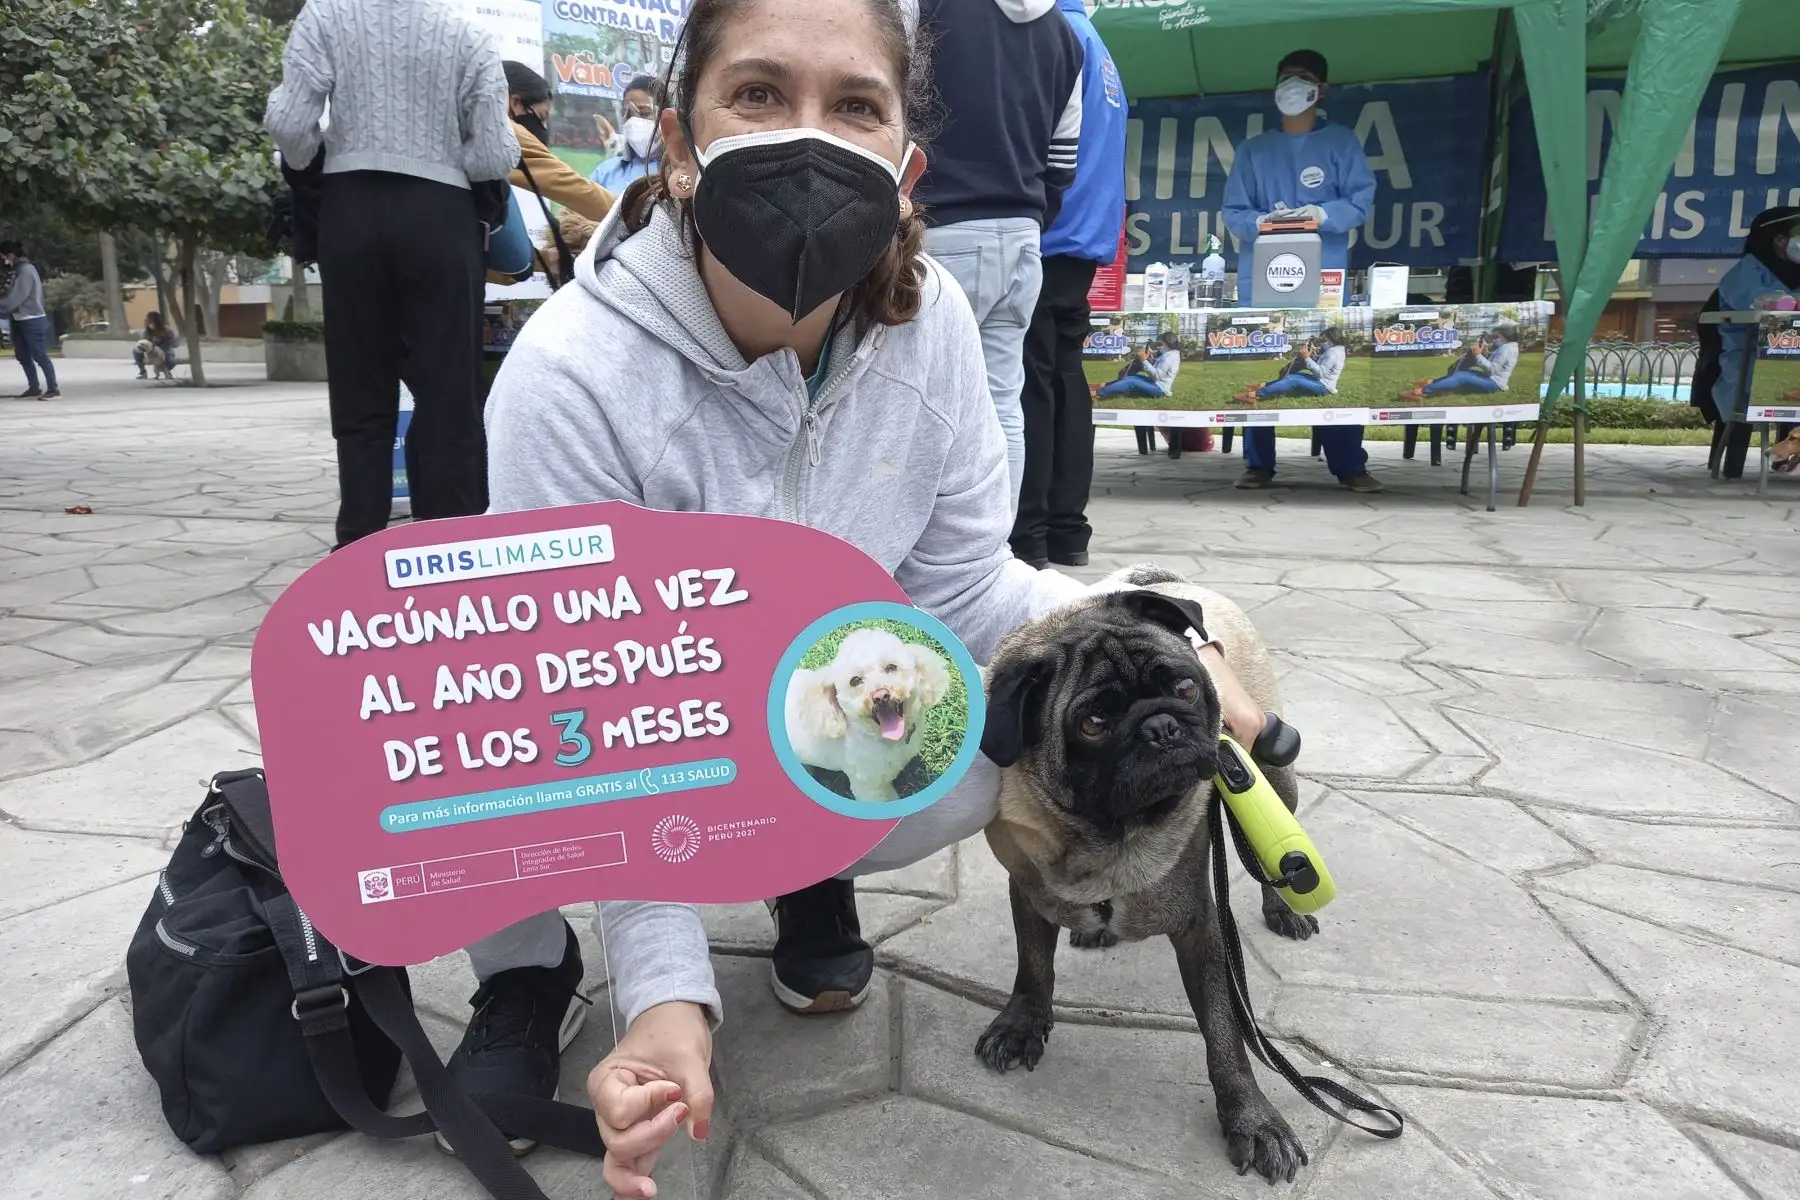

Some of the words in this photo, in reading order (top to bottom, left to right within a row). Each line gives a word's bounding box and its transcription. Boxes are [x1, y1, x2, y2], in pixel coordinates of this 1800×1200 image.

[557, 1, 632, 28] CONTRA
[635, 14, 656, 33] LA
[1268, 266, 1304, 276] MINSA
[307, 595, 537, 656] VACÚNALO
[553, 575, 642, 623] UNA
[654, 568, 748, 610] VEZ
[360, 674, 416, 720] AL
[432, 663, 522, 710] AÑO
[535, 620, 722, 693] DESPUÉS
[383, 736, 443, 781] DE
[456, 728, 538, 769] LOS
[550, 708, 592, 768] 3
[602, 699, 730, 750] MESES
[388, 813, 418, 825] Para
[422, 806, 450, 821] más
[453, 794, 533, 816] información
[536, 790, 572, 804] llama
[575, 780, 622, 796] GRATIS
[625, 778, 637, 790] al
[661, 772, 685, 786] 113
[687, 765, 730, 782] SALUD
[707, 817, 777, 832] BICENTENARIO
[736, 829, 756, 838] 2021
[521, 849, 552, 859] Dirección
[562, 844, 582, 853] Redes
[566, 851, 585, 859] Salud
[430, 868, 466, 880] Ministerio
[523, 865, 539, 873] Lima
[396, 873, 420, 886] PERÚ
[441, 876, 461, 886] Salud
